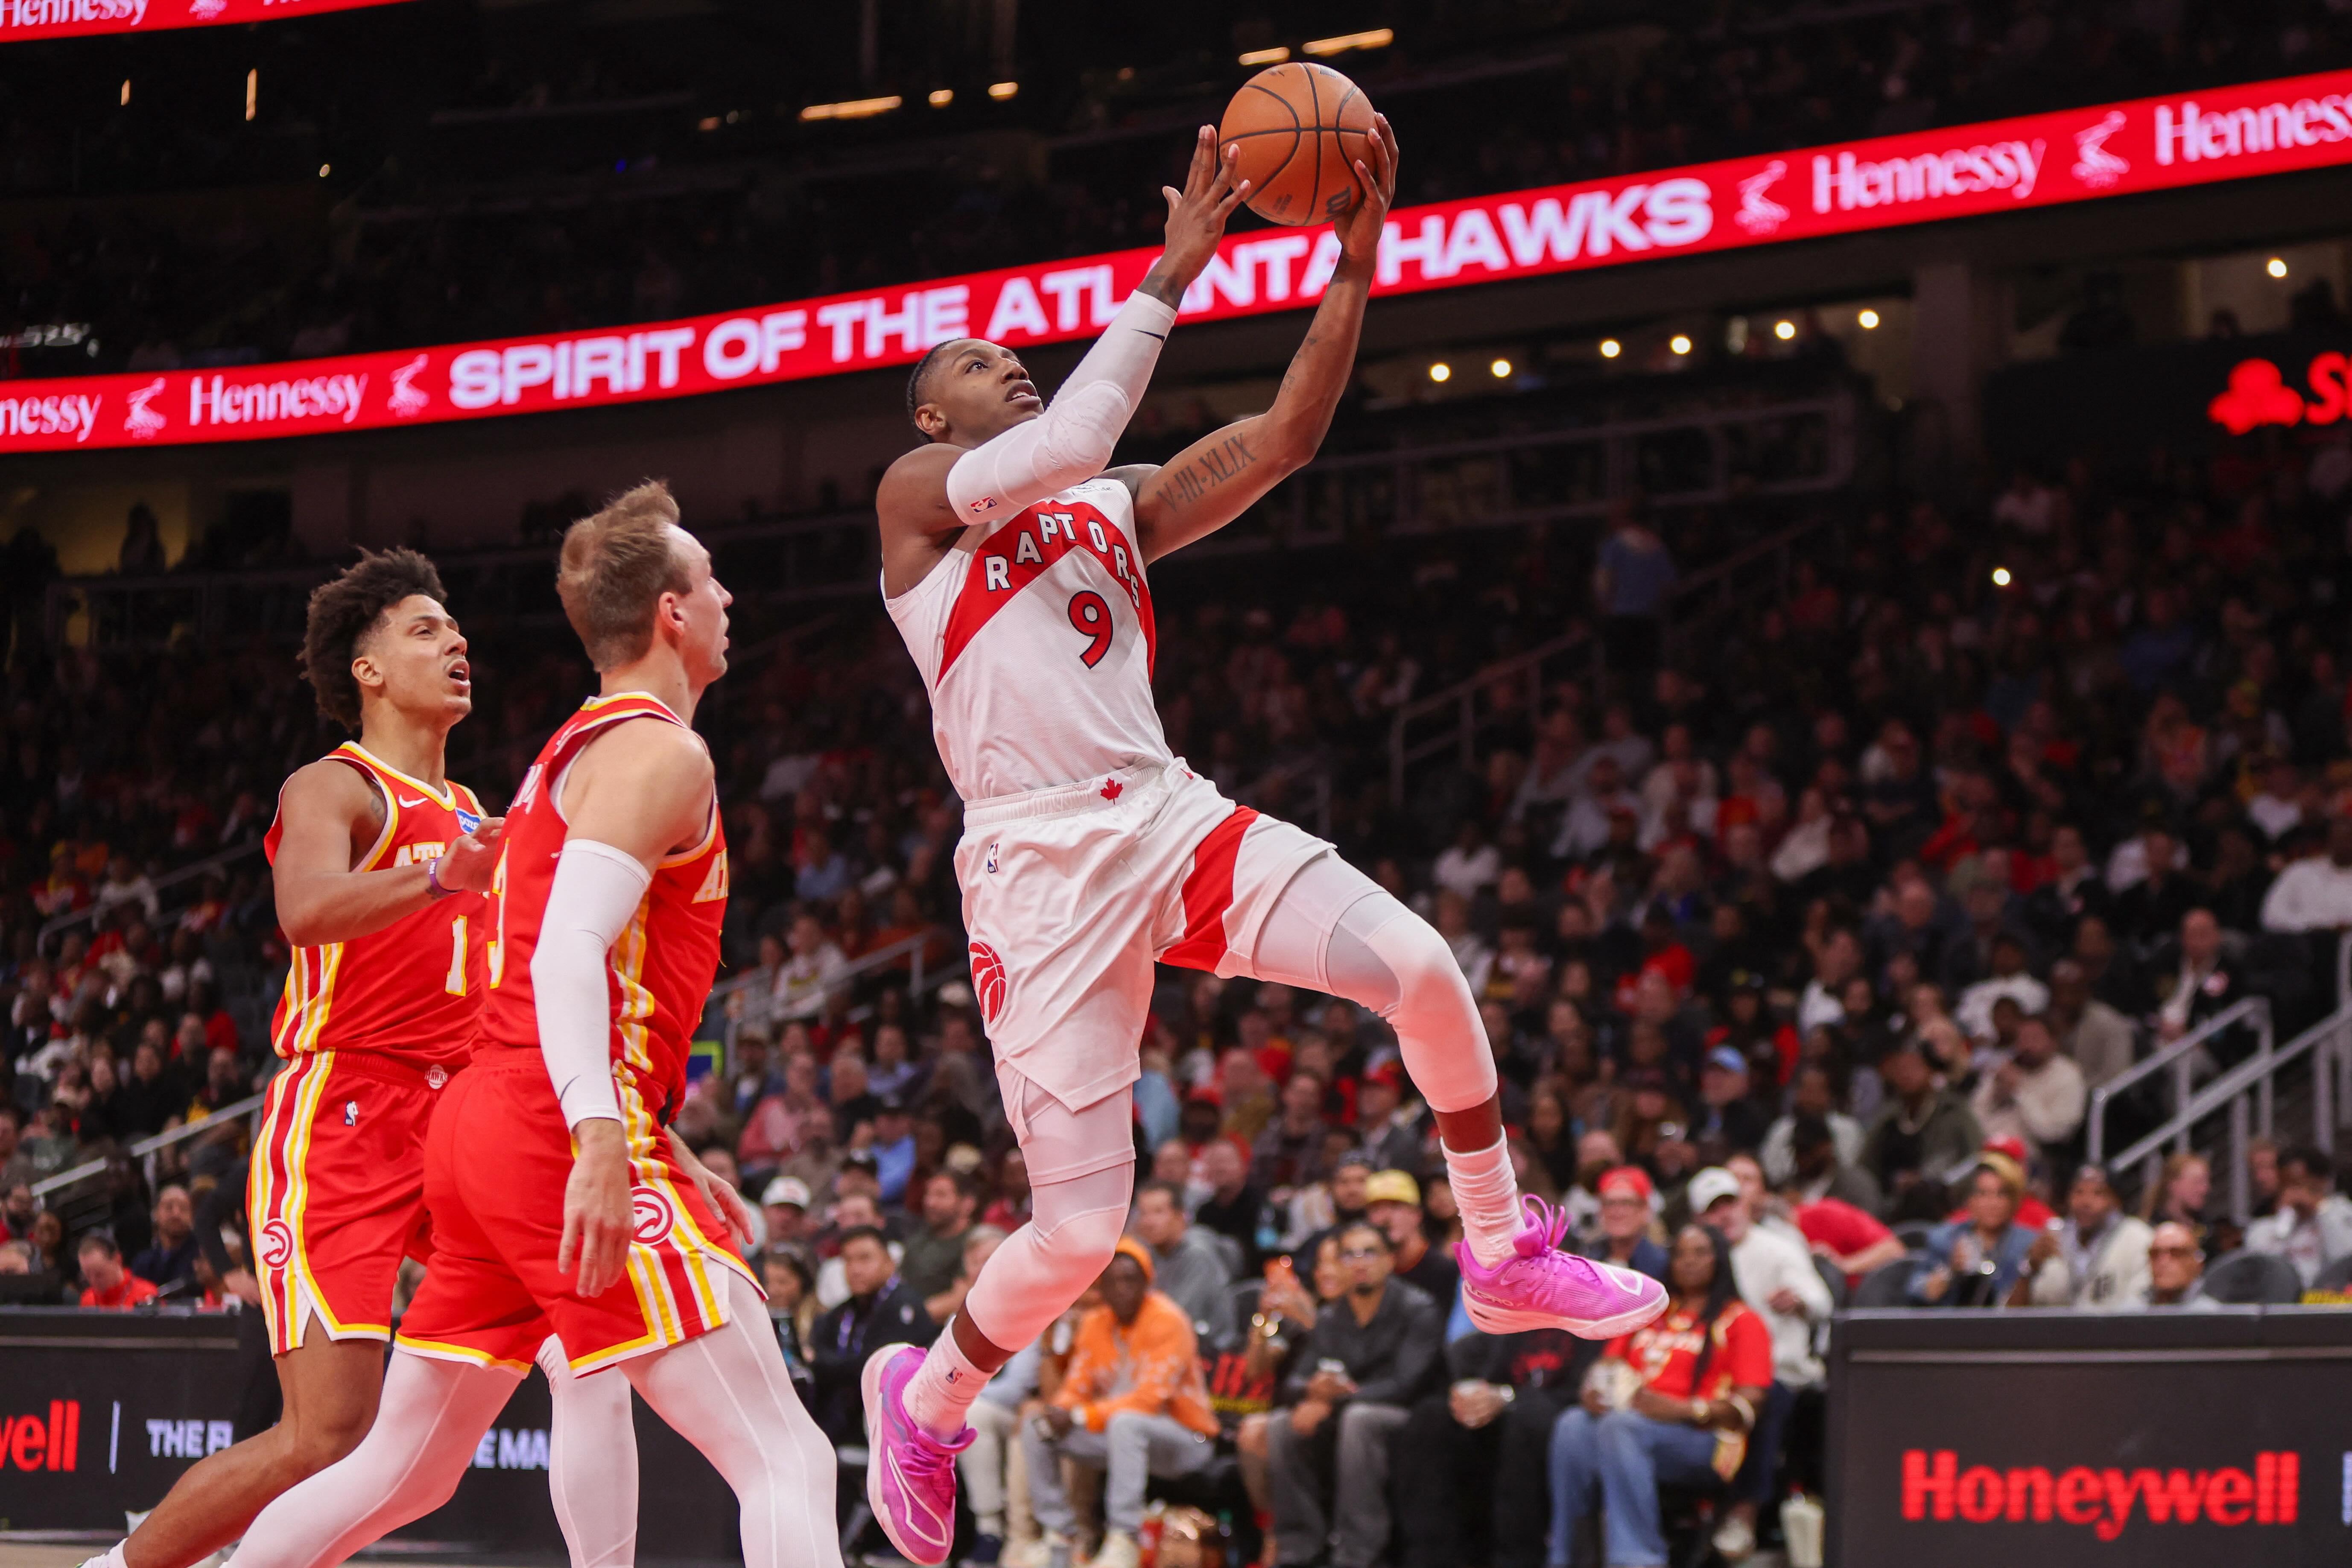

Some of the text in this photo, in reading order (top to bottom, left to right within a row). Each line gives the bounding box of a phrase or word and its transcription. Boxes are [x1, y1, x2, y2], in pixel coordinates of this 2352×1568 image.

[1811, 138, 2047, 214] Hennessy
[450, 327, 695, 409] SPIRIT
[703, 309, 808, 380] OF
[817, 284, 970, 363] THE
[1376, 177, 1713, 286] HAWKS
[189, 373, 370, 426] Hennessy
[2305, 351, 2352, 425] S
[985, 512, 1140, 609] RAPTORS
[1068, 590, 1113, 670] 9
[445, 914, 468, 997] 1
[146, 1419, 205, 1458] THE
[1901, 1449, 2300, 1541] Honeywell
